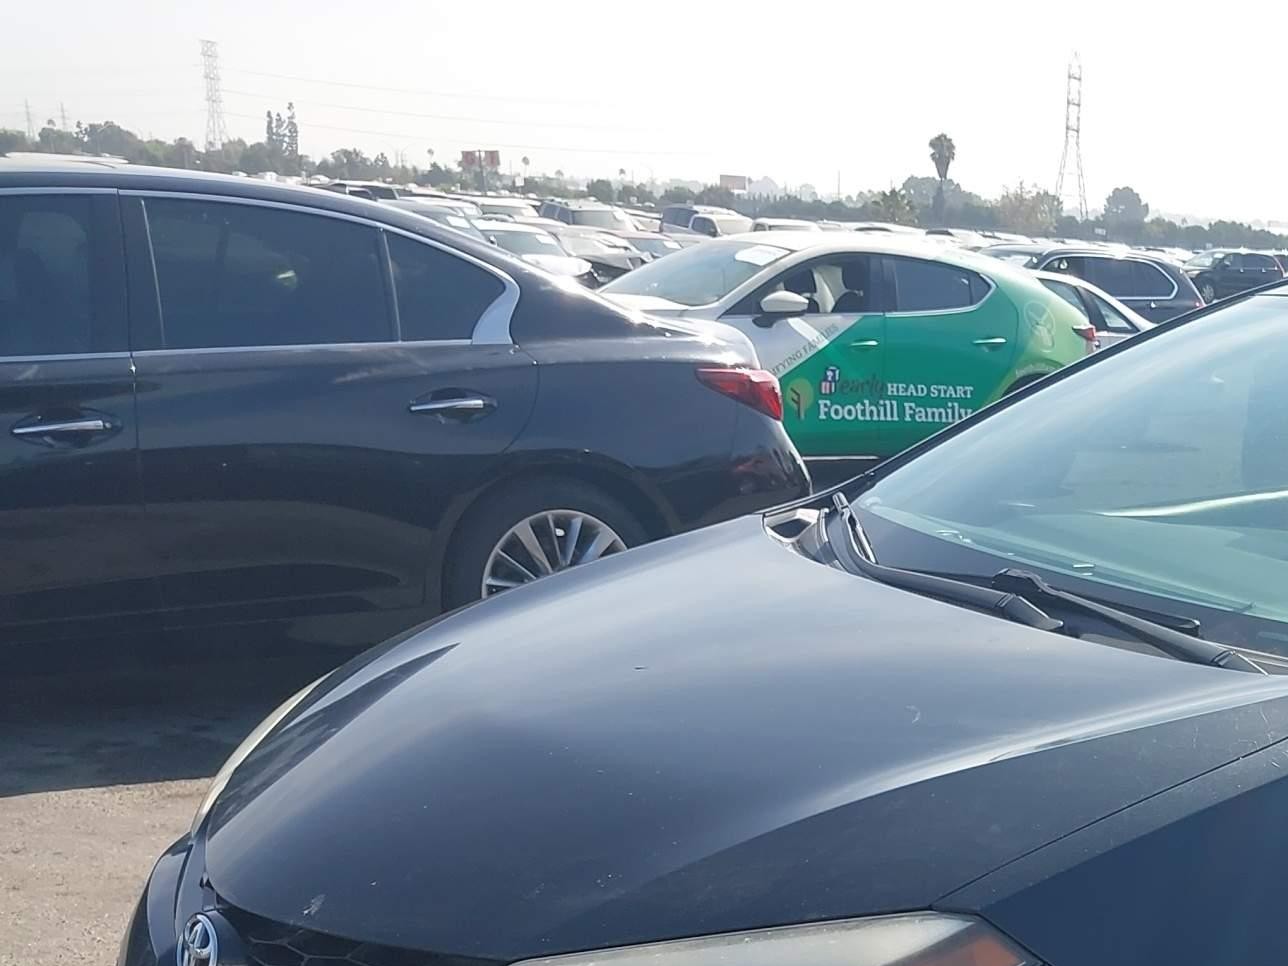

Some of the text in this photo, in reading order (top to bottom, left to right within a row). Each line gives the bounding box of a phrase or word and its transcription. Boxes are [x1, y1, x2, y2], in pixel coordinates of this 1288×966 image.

[838, 376, 974, 400] early HEAD START
[818, 399, 973, 423] Foothill Family
